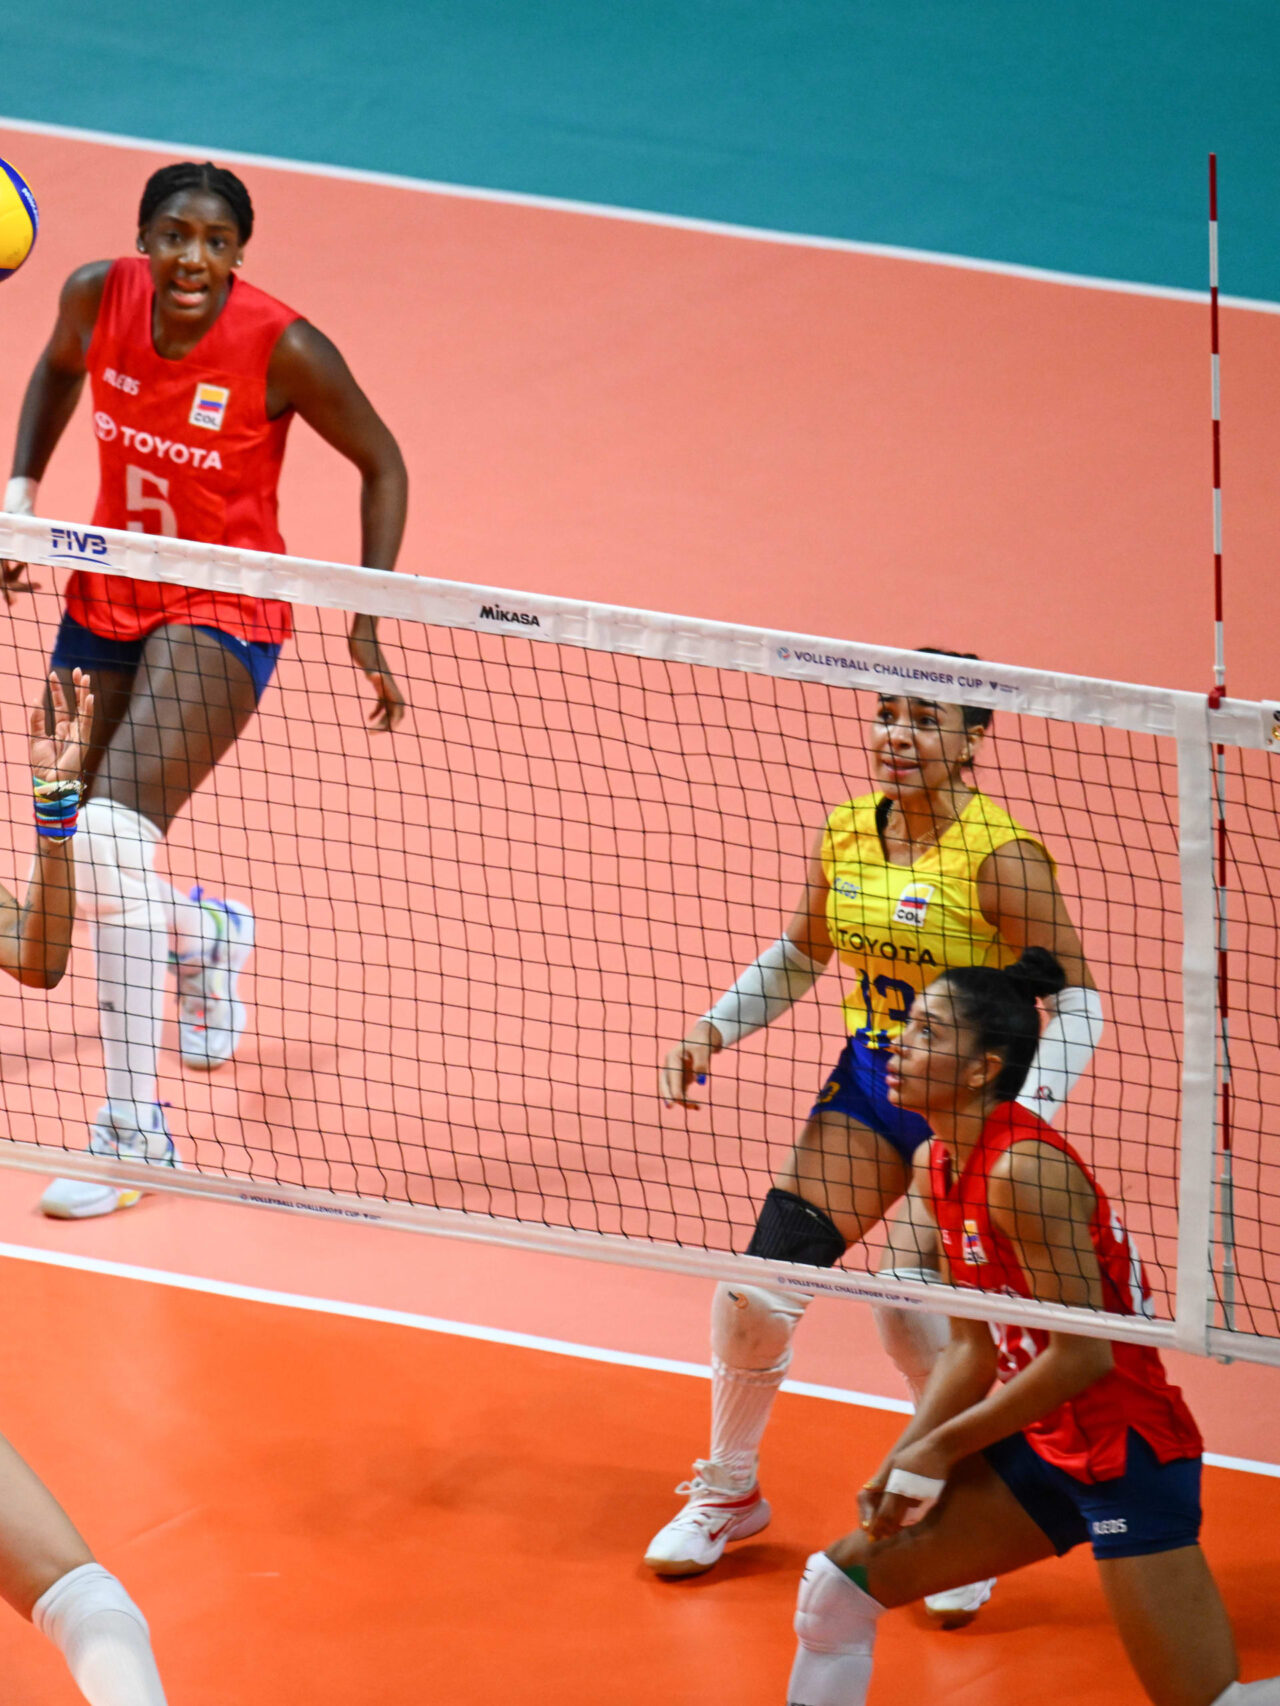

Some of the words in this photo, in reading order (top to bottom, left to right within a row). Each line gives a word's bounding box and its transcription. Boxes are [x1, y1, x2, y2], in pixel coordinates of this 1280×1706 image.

[194, 412, 218, 427] COL
[120, 426, 222, 470] TOYOTA
[126, 463, 178, 539] 5
[51, 528, 108, 555] FIVB
[794, 650, 869, 672] VOLLEYBALL
[873, 663, 954, 685] CHALLENGER
[958, 676, 983, 689] CUP
[897, 909, 922, 924] COL
[838, 929, 936, 967] TOYOTA
[250, 1194, 294, 1208] VOLLEYBALL
[296, 1202, 344, 1215] CHALLENGER
[788, 1278, 833, 1291] VOLLEYBALL
[835, 1285, 884, 1298] CHALLENGER
[885, 1292, 900, 1300] CUP
